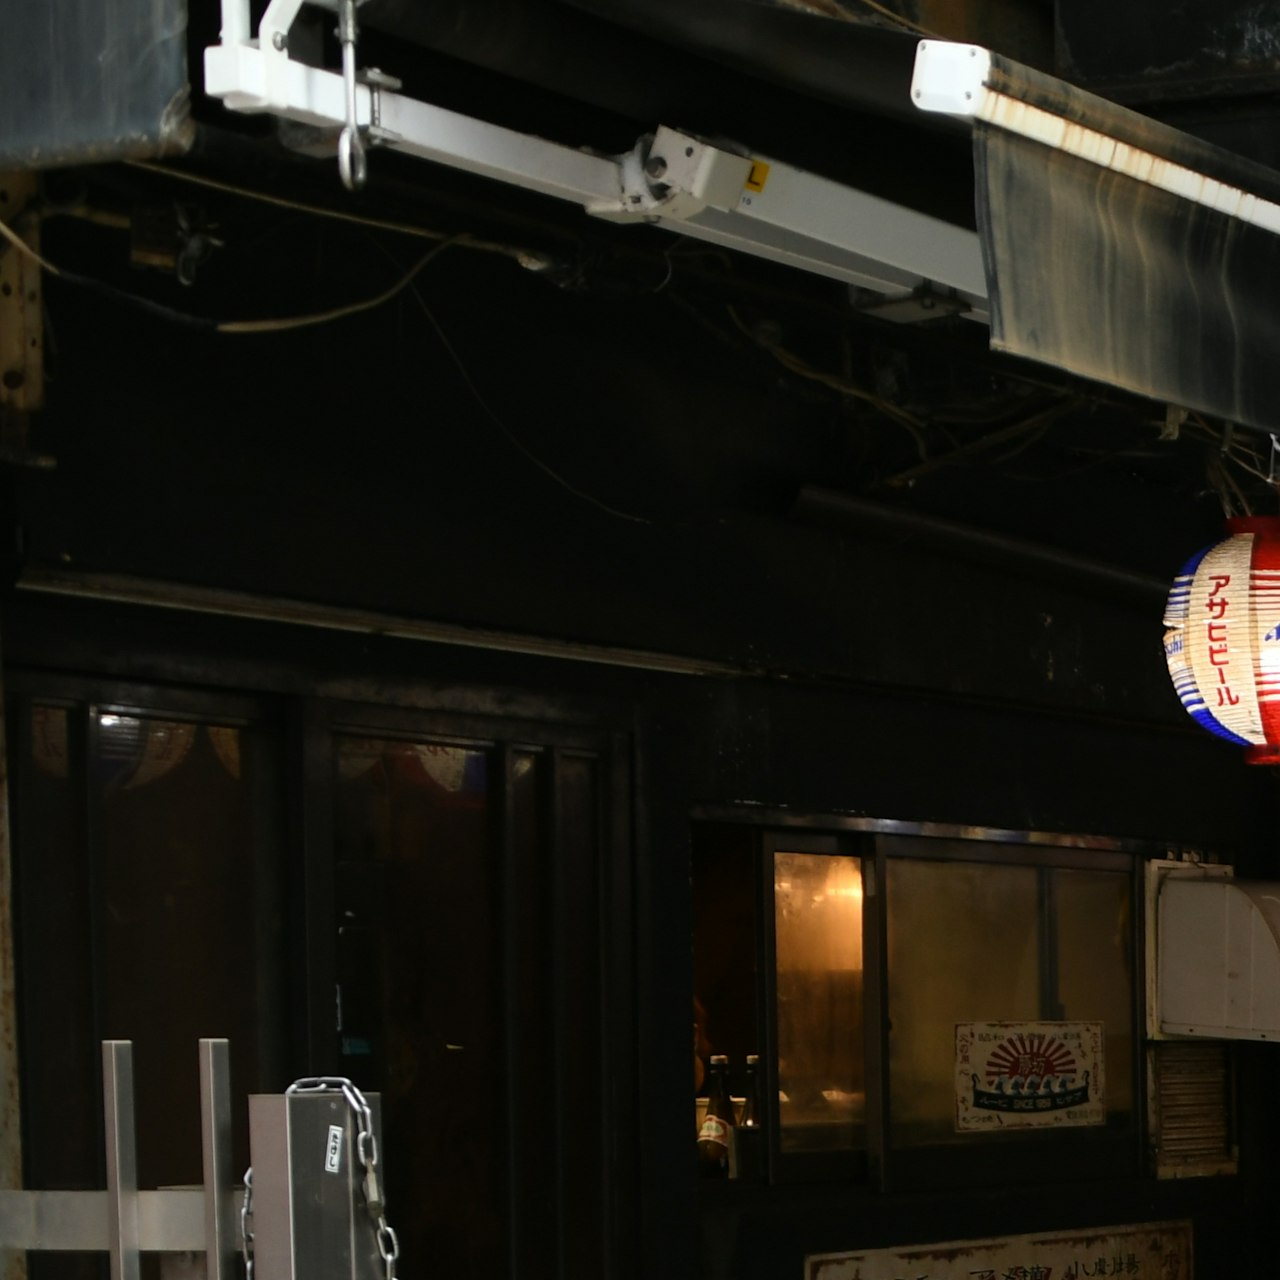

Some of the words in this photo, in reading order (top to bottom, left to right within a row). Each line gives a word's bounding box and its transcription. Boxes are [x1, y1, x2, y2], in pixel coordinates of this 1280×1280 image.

[1165, 632, 1184, 656] sahi
[1206, 575, 1239, 707] アサヒビール
